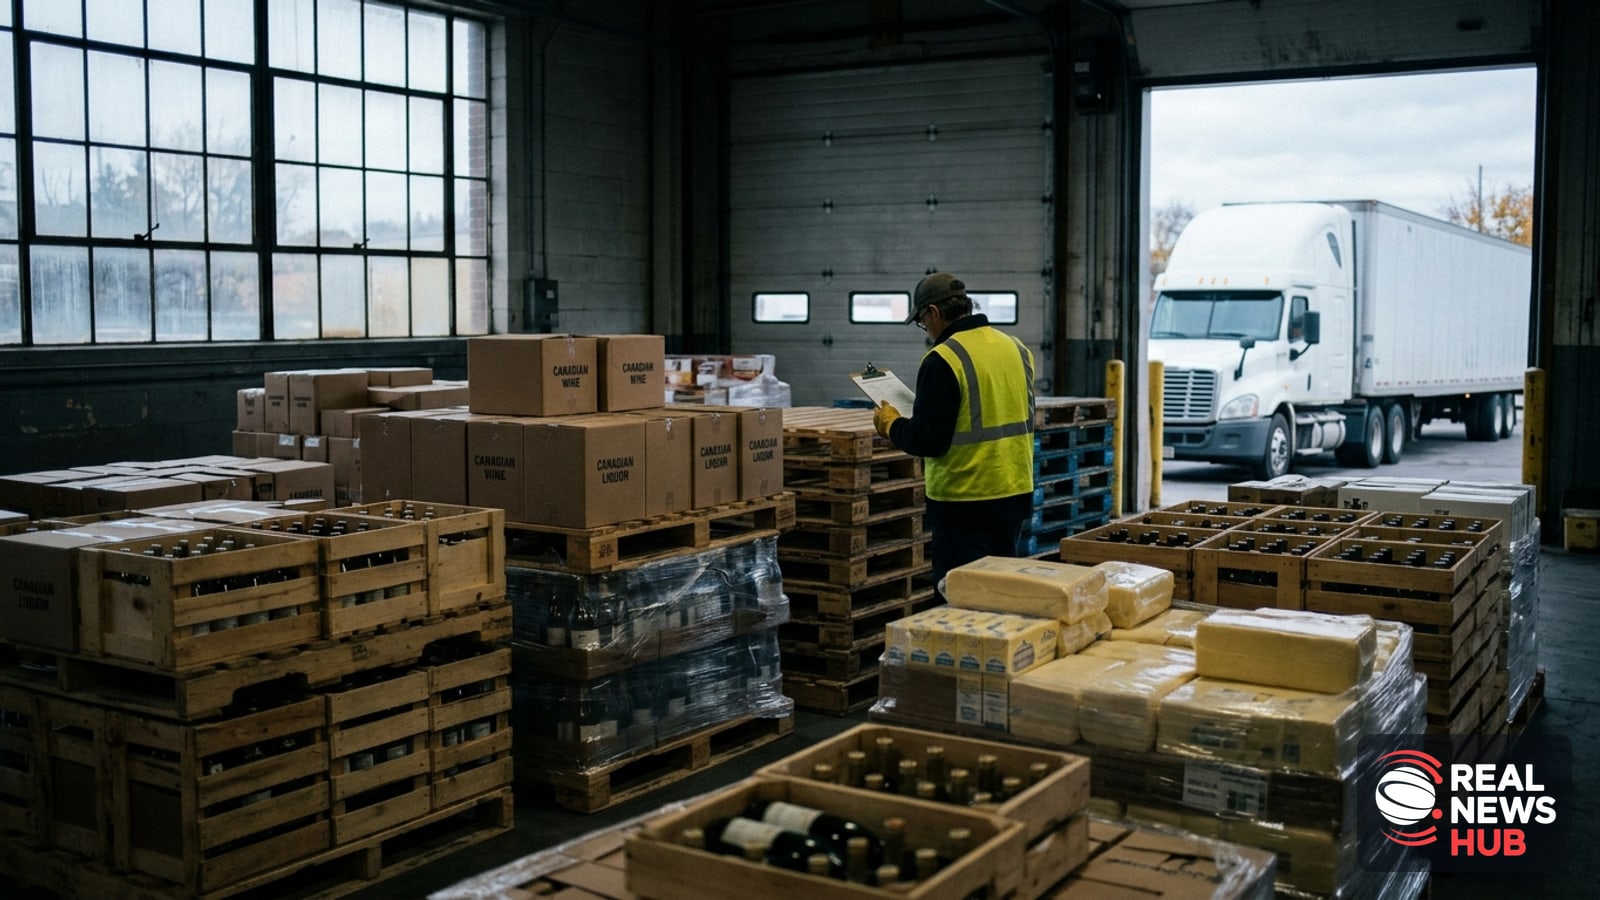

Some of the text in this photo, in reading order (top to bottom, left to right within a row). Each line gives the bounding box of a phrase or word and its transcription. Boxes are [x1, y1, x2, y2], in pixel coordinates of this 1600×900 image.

[553, 365, 589, 376] CANADIAN
[561, 377, 581, 388] WINE
[596, 456, 635, 471] CANADIAN
[484, 469, 507, 481] WINE
[602, 470, 630, 484] LIQUOR
